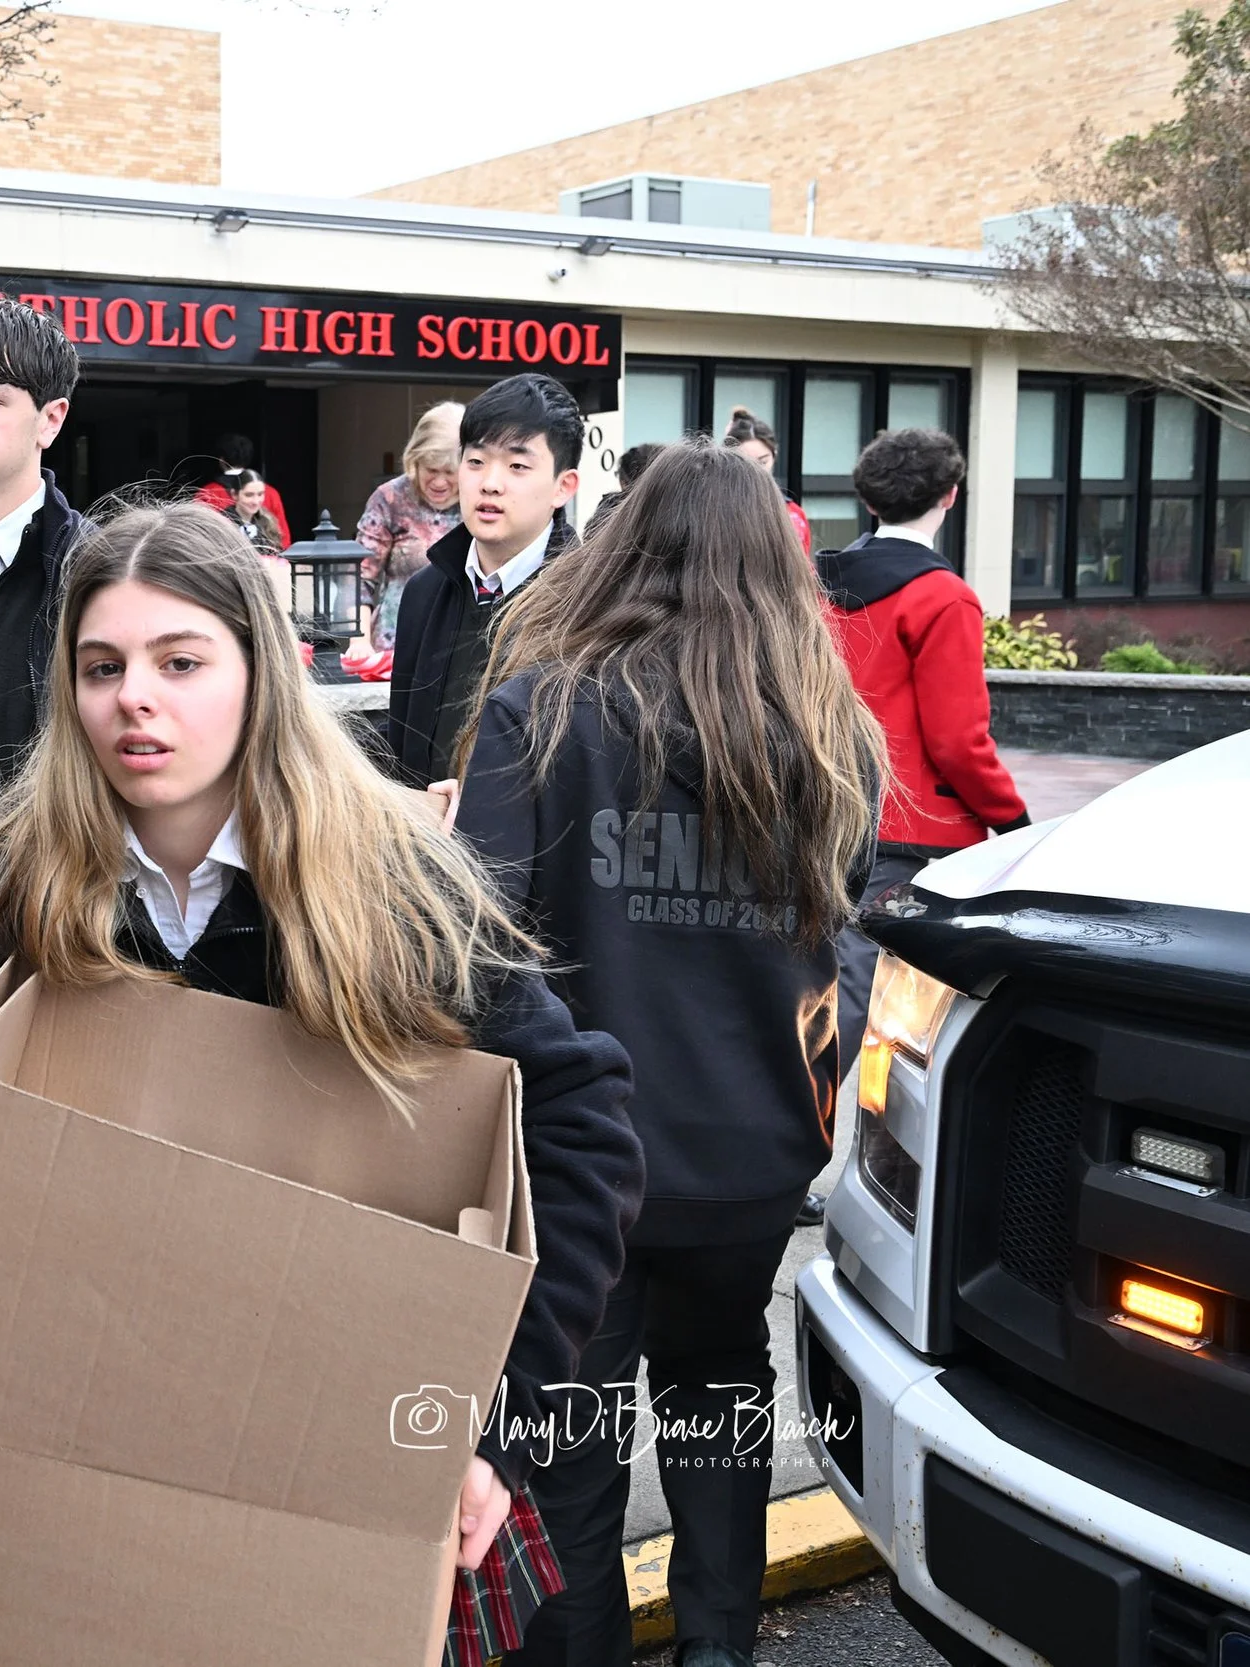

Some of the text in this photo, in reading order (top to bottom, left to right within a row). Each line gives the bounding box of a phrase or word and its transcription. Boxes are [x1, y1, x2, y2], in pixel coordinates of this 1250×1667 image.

[259, 306, 396, 357] HIGH
[417, 315, 610, 366] SCHOOL
[627, 894, 701, 926] CLASS
[704, 899, 734, 928] OF
